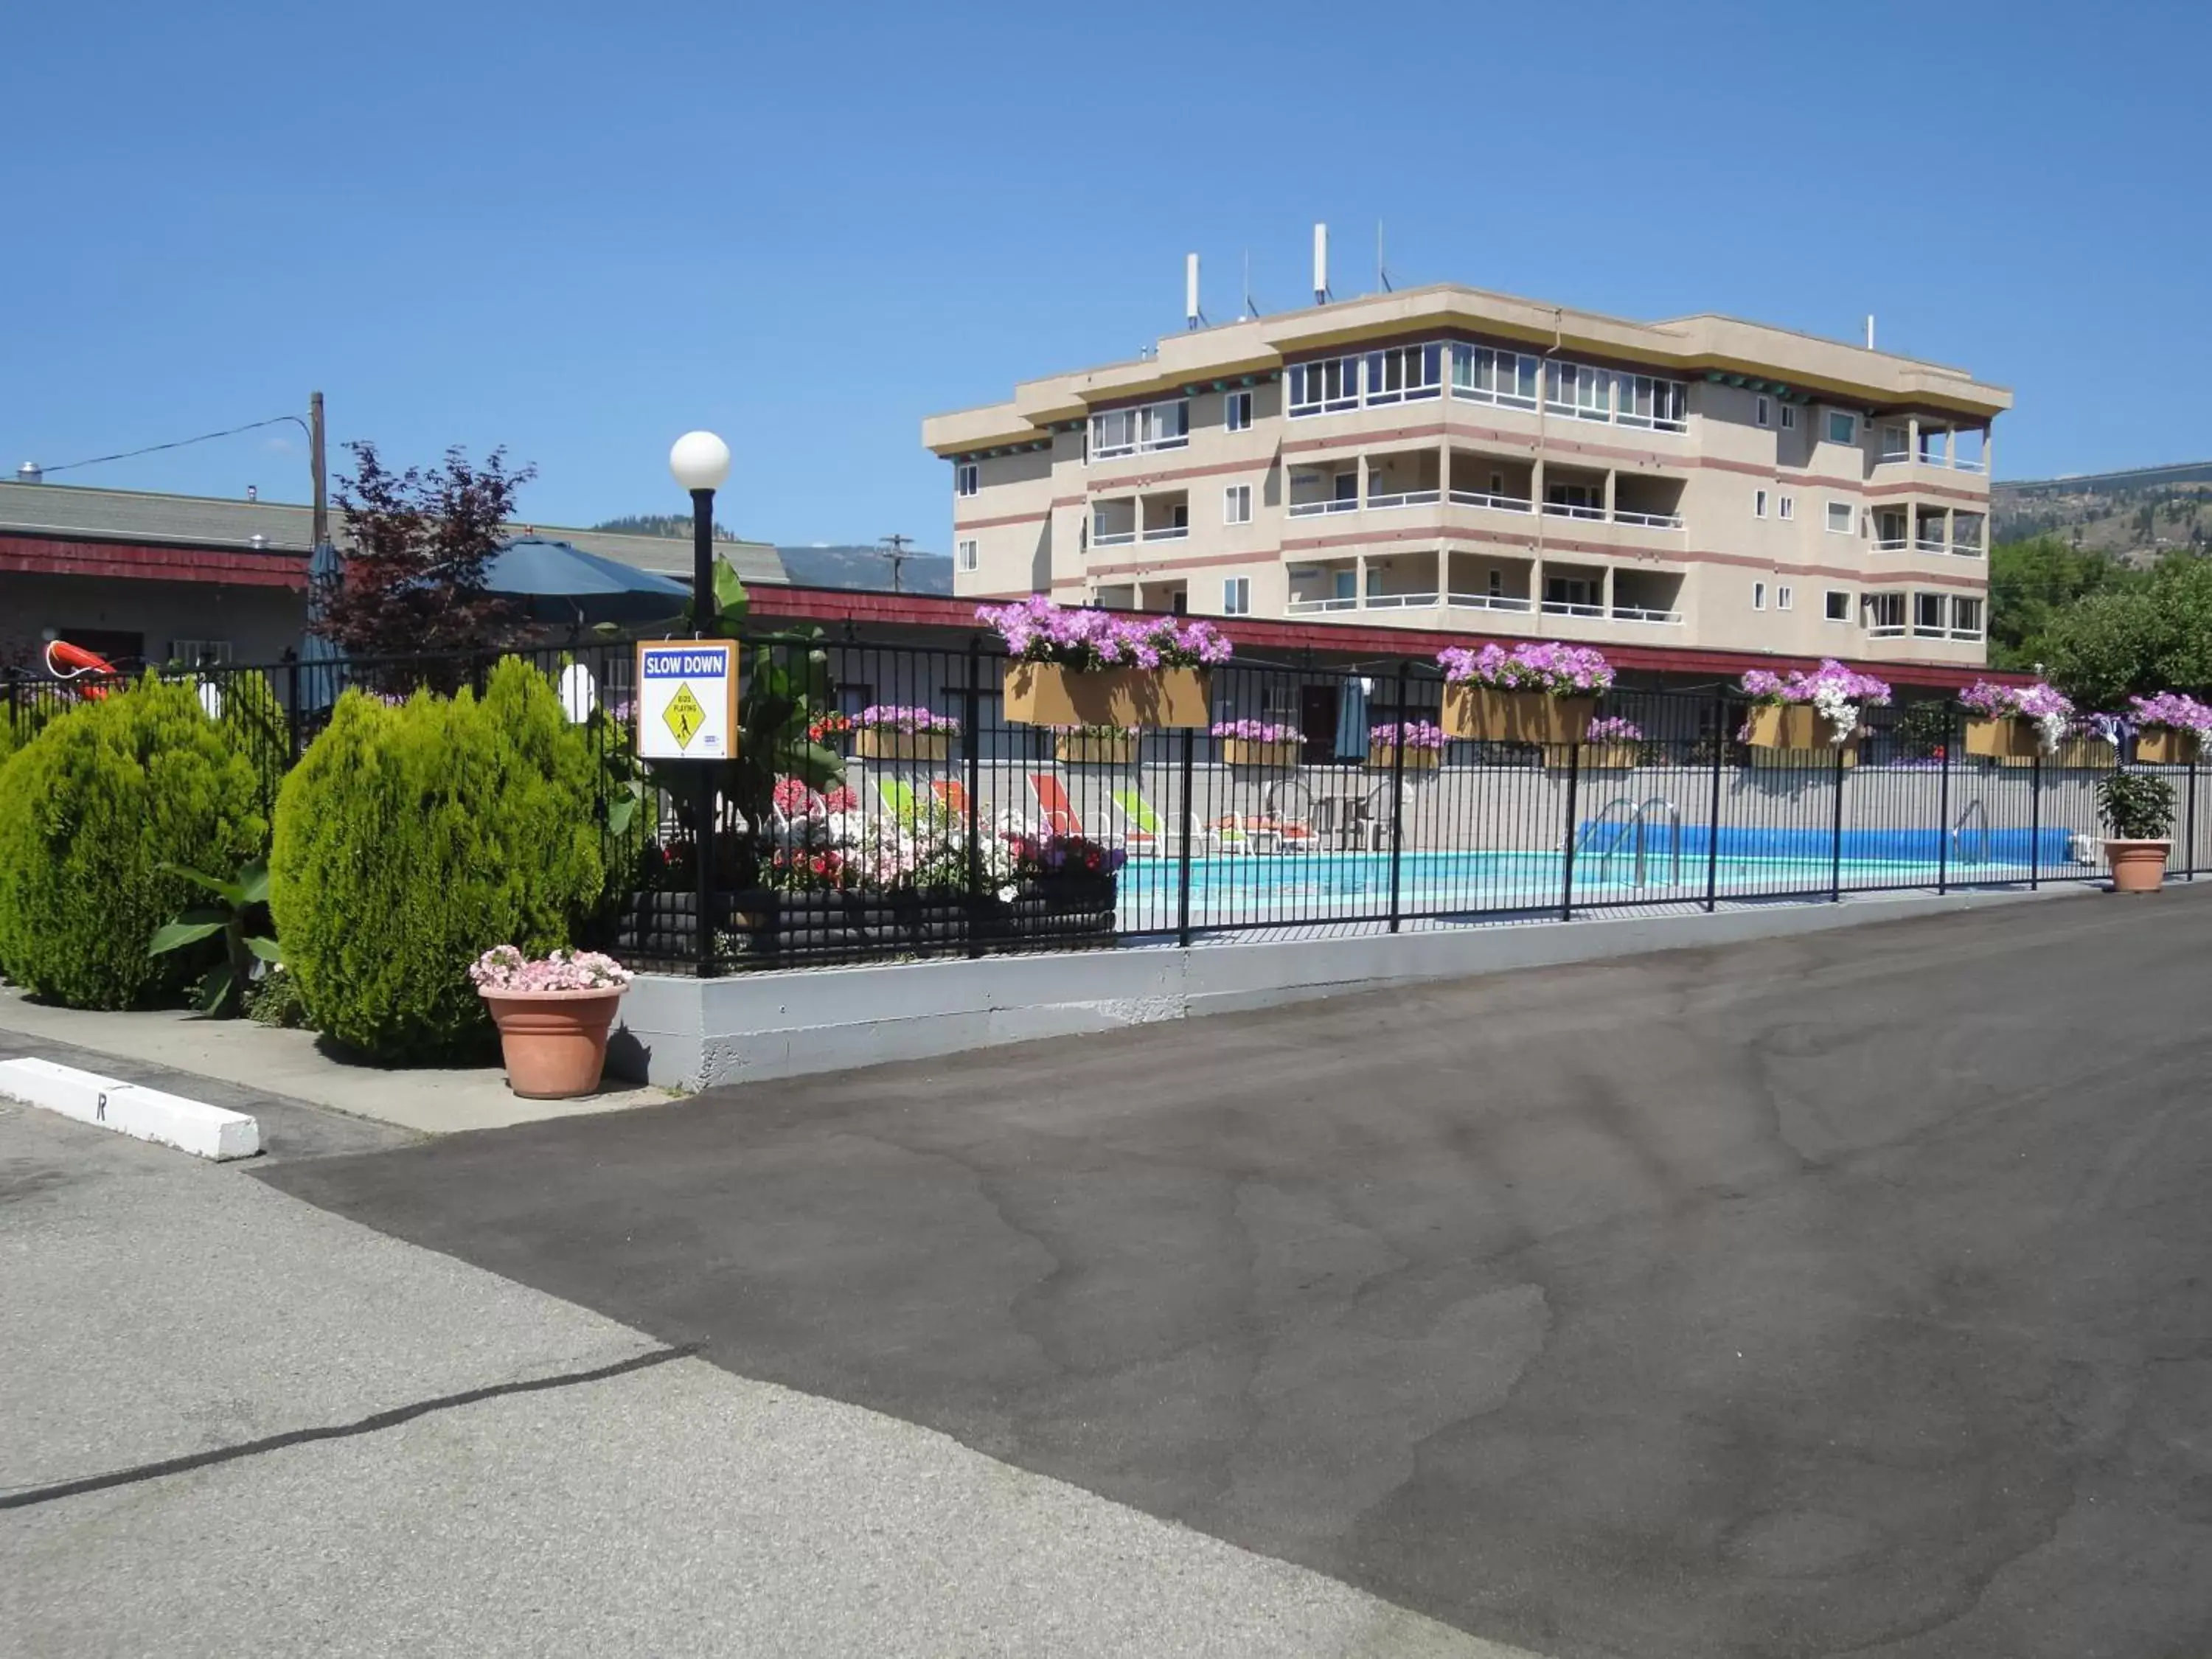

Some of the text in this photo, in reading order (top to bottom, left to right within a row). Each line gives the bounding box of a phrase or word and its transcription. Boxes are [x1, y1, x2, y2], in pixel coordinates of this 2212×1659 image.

[647, 655, 723, 674] SLOW DOWN
[97, 1092, 107, 1121] R
